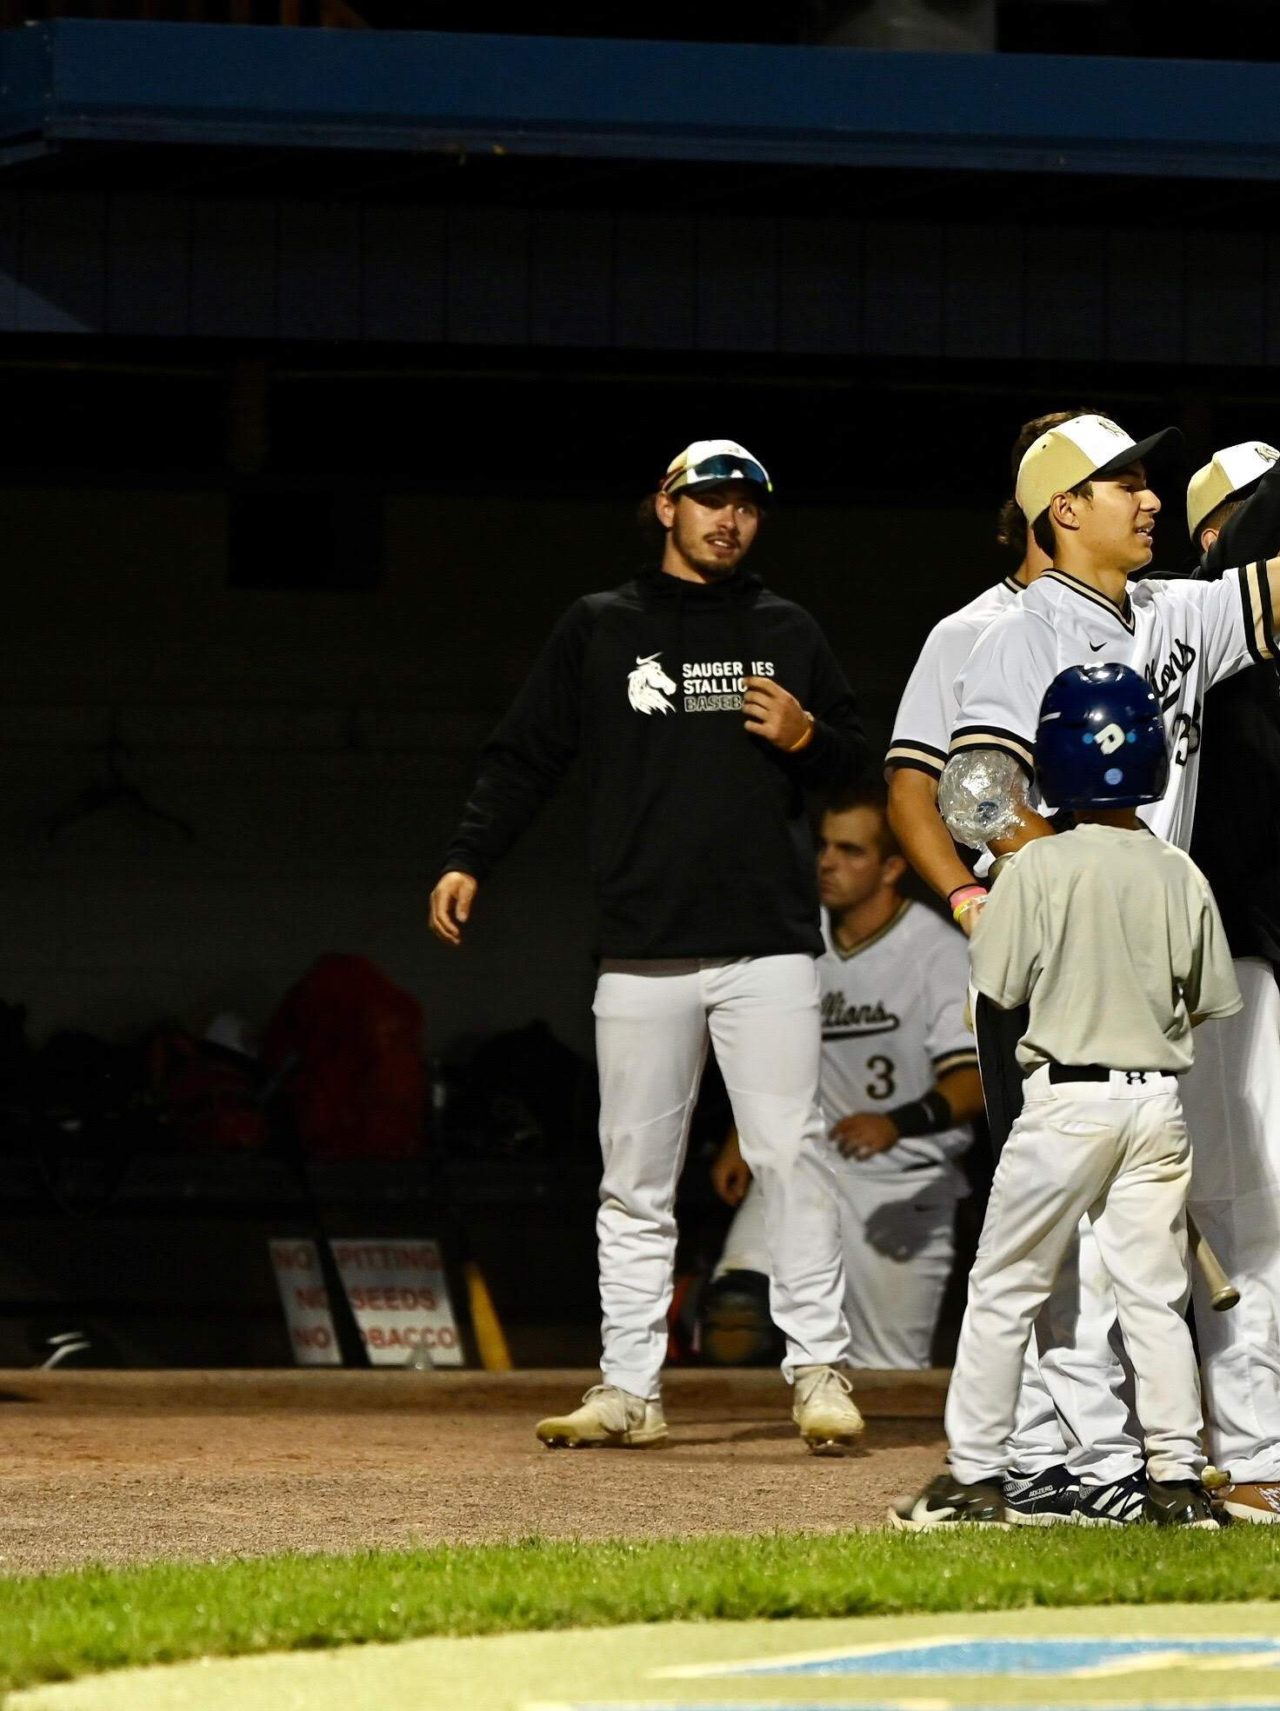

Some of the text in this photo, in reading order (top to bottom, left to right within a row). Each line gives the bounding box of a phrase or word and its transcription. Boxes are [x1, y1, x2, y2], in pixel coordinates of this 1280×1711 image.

[682, 661, 775, 678] SAUGERIES
[683, 677, 748, 695] STALLIO
[684, 694, 743, 712] BASEB
[866, 1055, 896, 1101] 3
[277, 1246, 443, 1270] NO PITTING
[349, 1287, 438, 1310] SEEDS
[294, 1327, 331, 1349] NO
